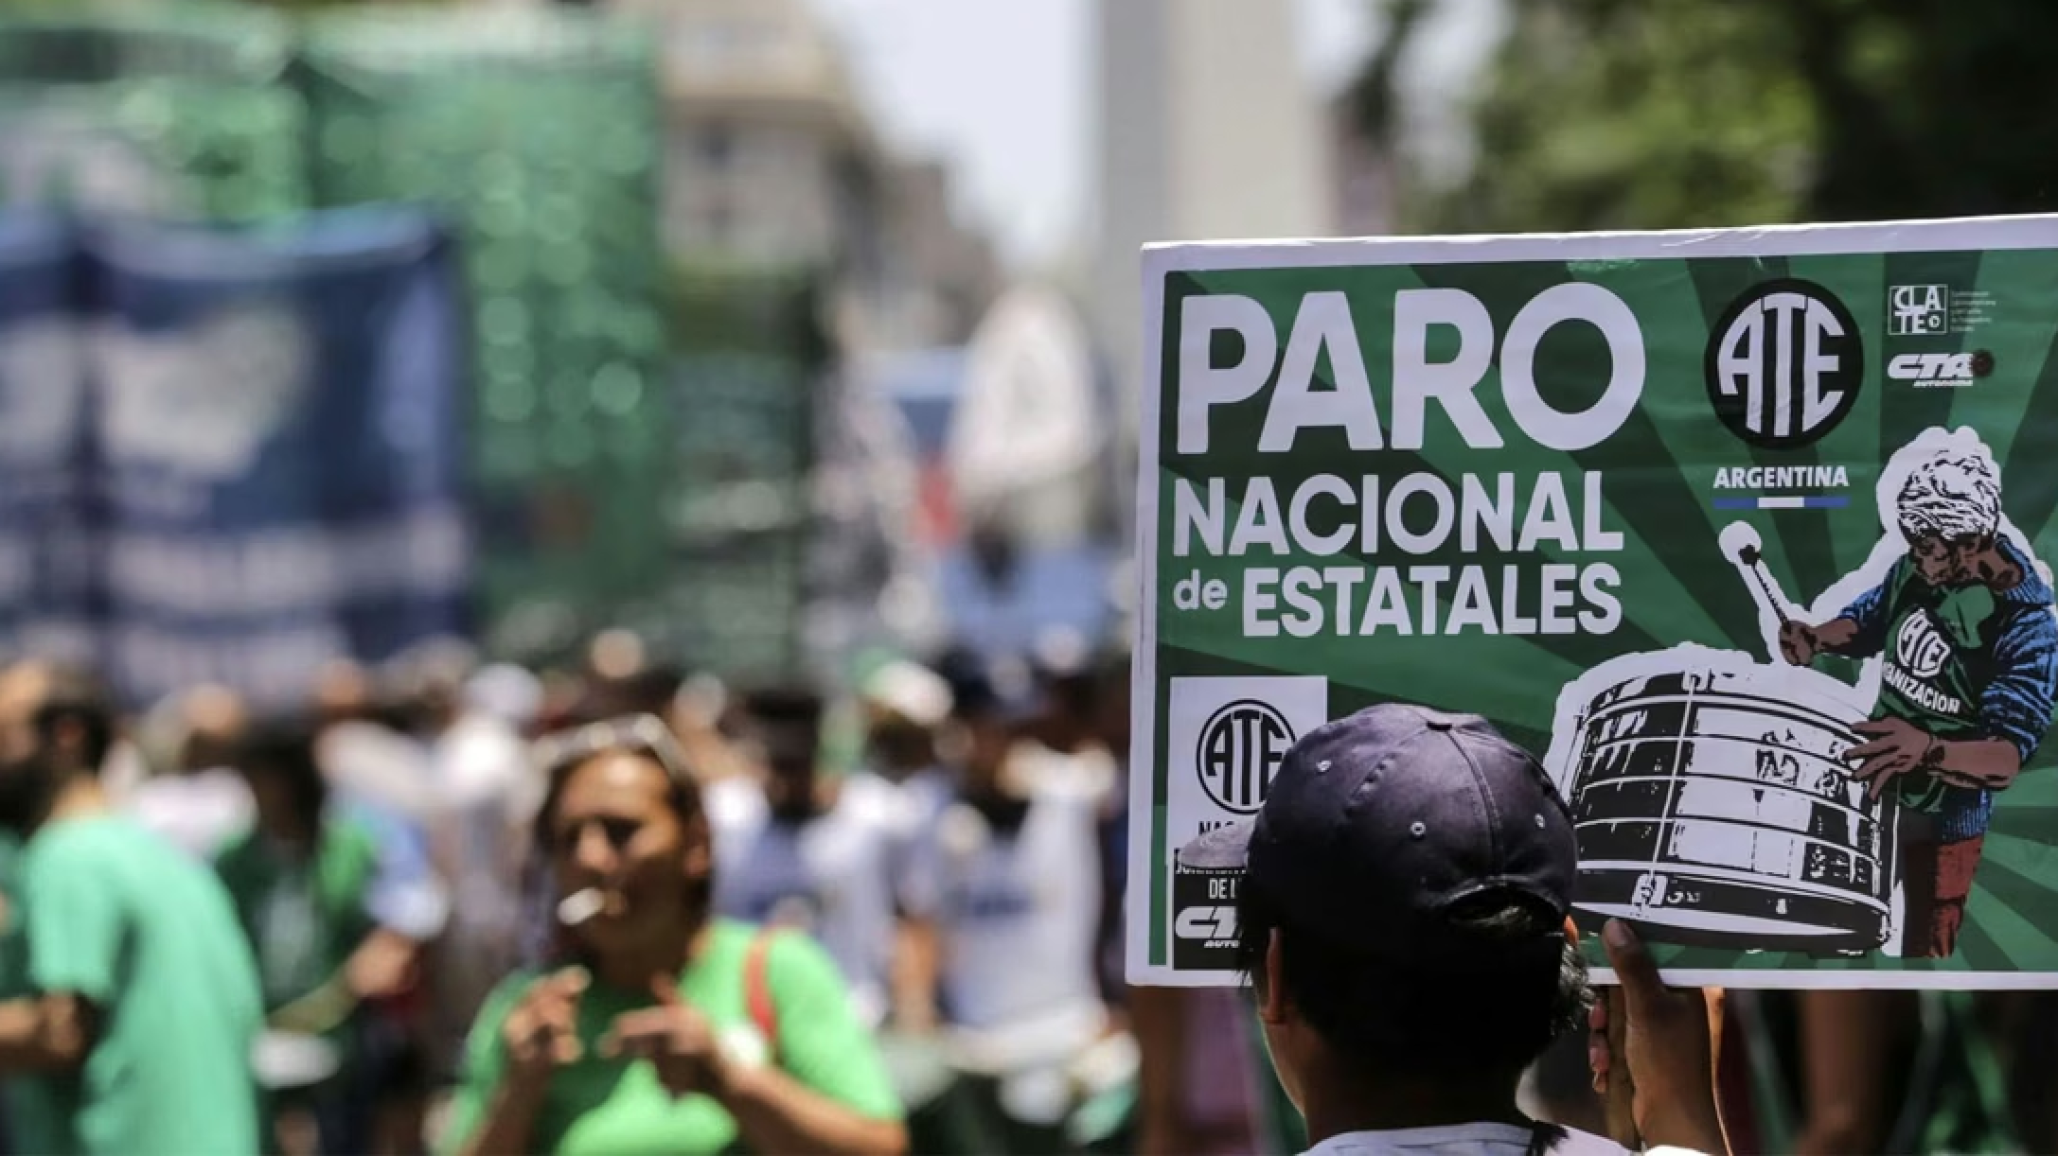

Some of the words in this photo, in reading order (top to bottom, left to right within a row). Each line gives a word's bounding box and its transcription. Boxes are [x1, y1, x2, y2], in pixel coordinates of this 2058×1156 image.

[1177, 281, 1646, 454] PARO
[1717, 292, 1845, 438] ATE
[1173, 470, 1625, 557] NACIONAL
[1712, 465, 1849, 489] ARGENTINA
[1173, 569, 1228, 611] de
[1243, 562, 1623, 638] ESTATALES
[1174, 905, 1241, 939] CT
[1208, 877, 1229, 900] DE
